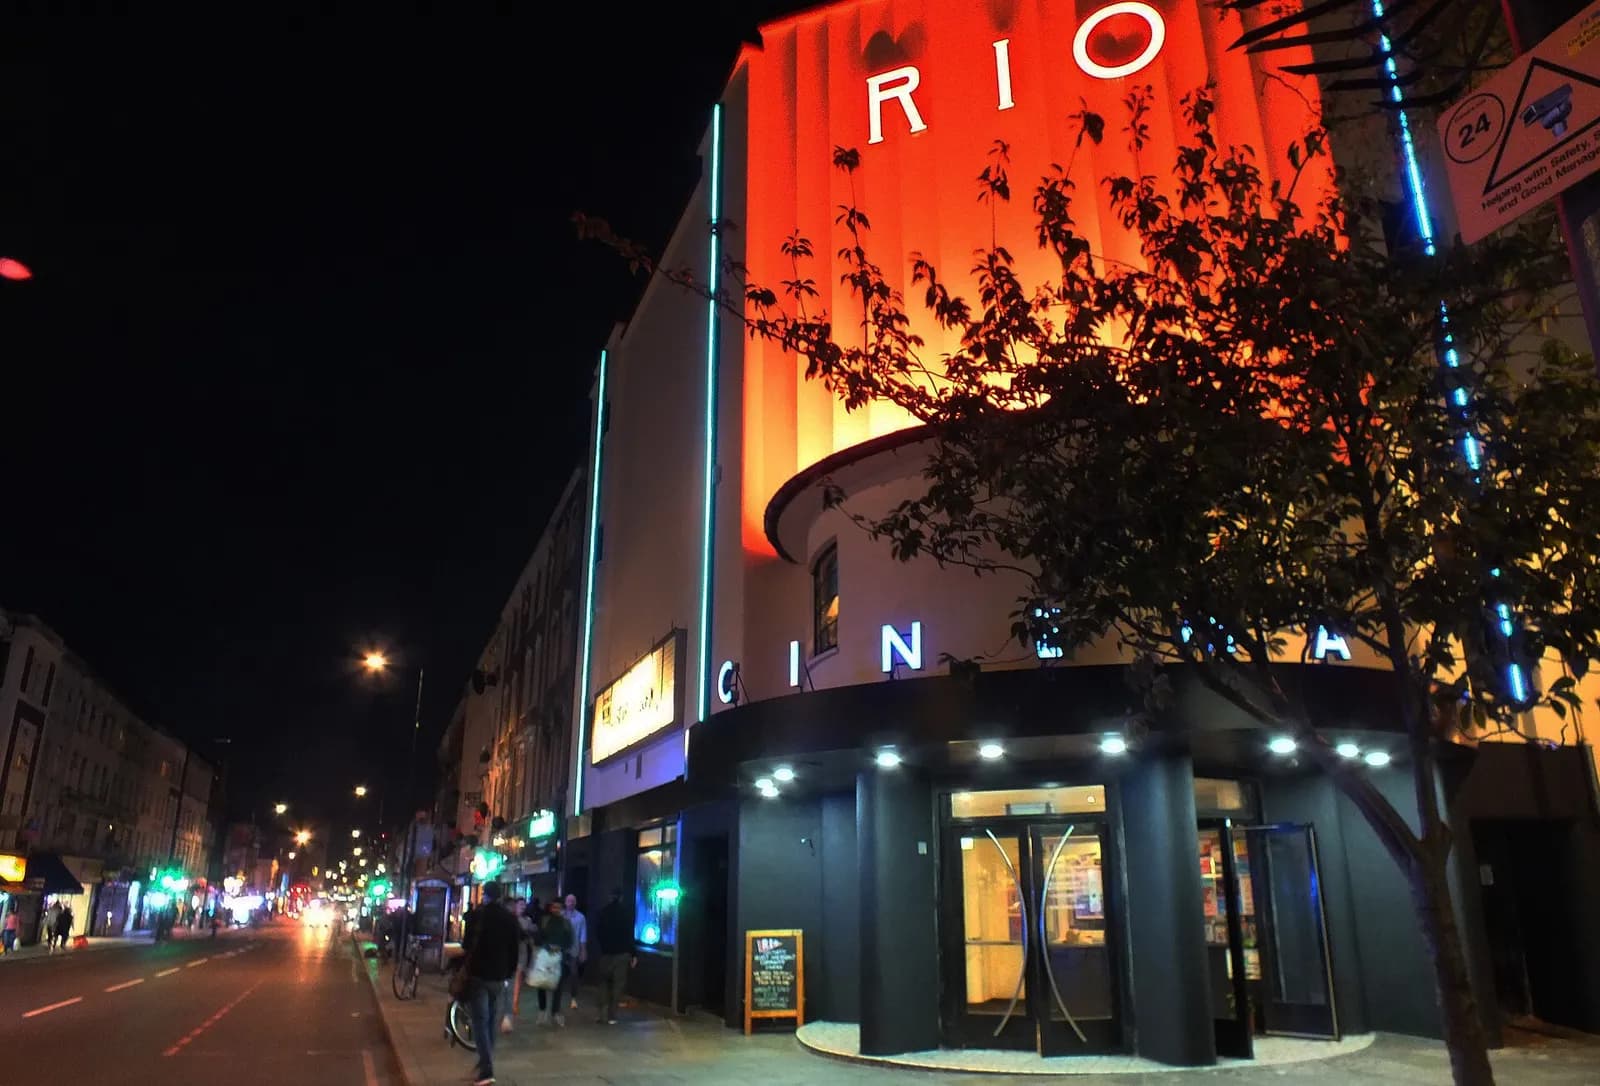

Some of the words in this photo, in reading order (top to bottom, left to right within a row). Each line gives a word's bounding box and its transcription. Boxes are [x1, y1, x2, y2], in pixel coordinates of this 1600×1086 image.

[866, 1, 1165, 144] RIO
[1459, 112, 1491, 148] 24
[1482, 182, 1522, 210] Helping
[1524, 165, 1548, 184] with
[1498, 196, 1518, 214] and
[1521, 175, 1553, 200] Good
